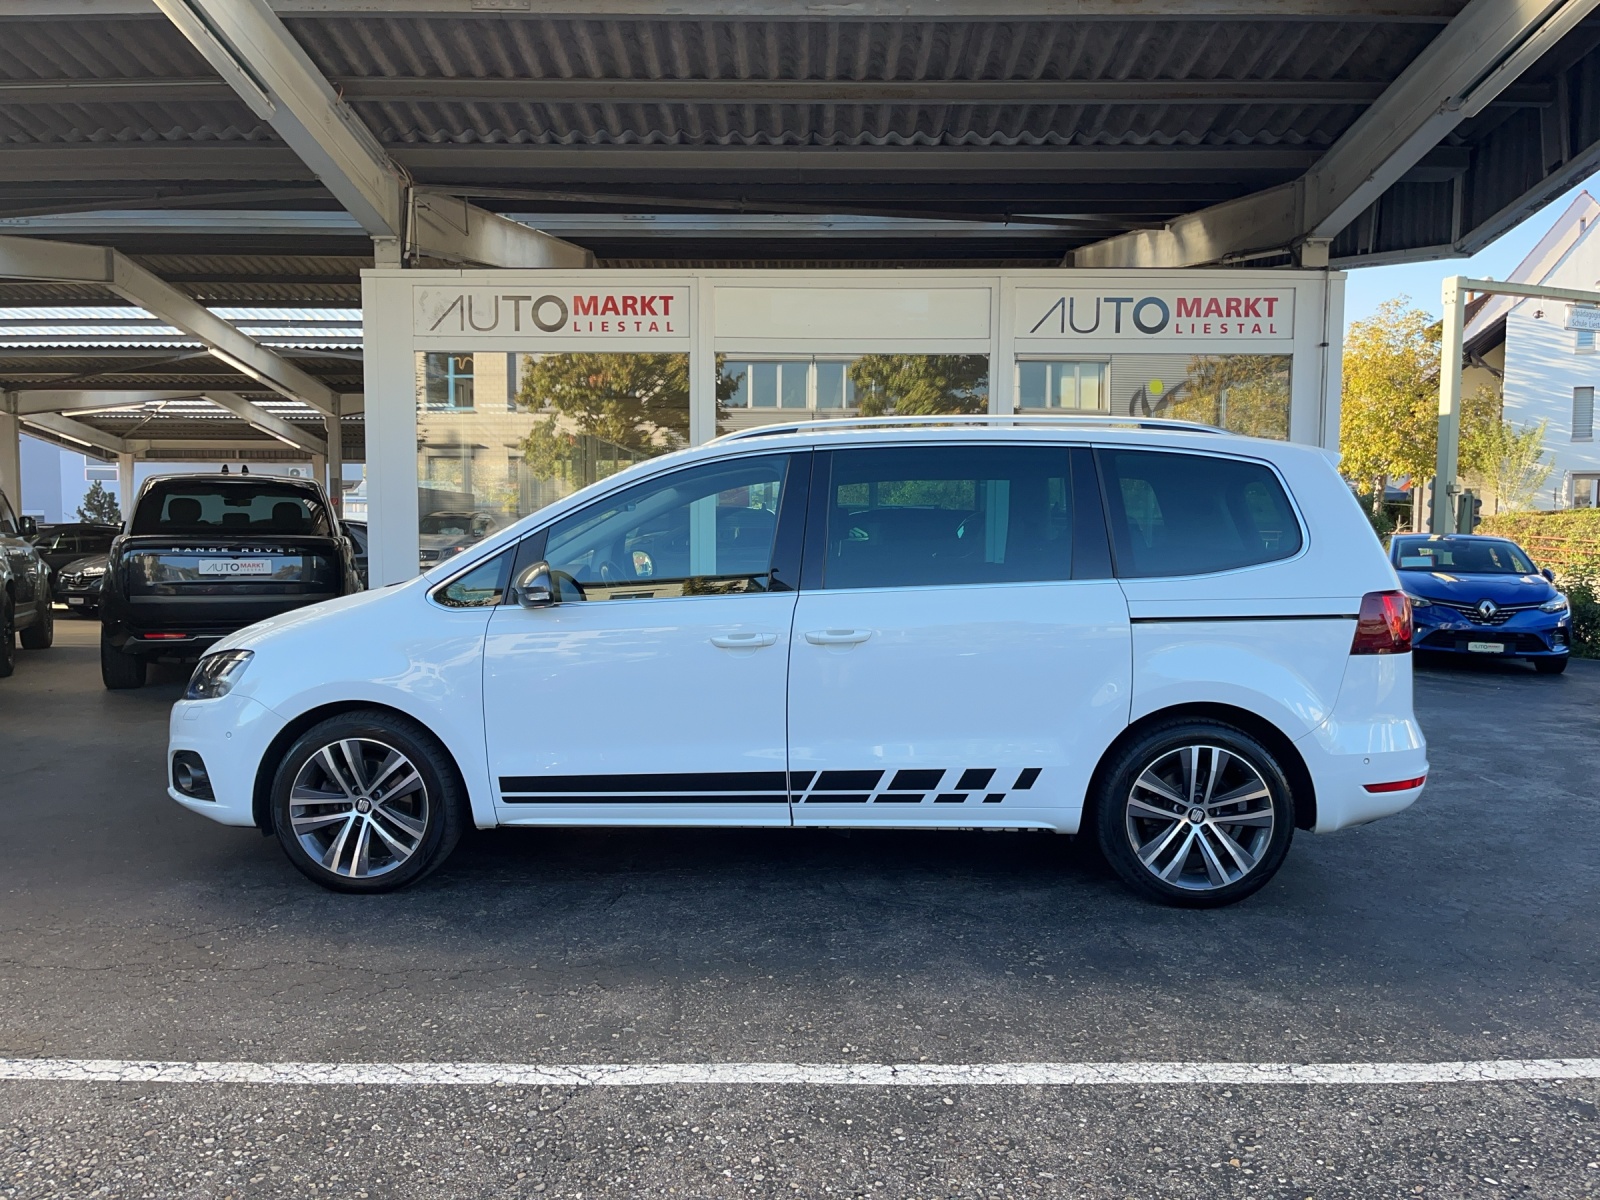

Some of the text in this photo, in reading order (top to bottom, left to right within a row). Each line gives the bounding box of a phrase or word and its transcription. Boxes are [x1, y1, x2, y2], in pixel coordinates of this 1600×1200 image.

[429, 294, 675, 332] AUTO MARKT
[1029, 296, 1279, 334] AUTO MARKT
[573, 321, 675, 332] LIESTAL
[1175, 323, 1278, 334] LIESTAL
[206, 563, 240, 572] AUTO
